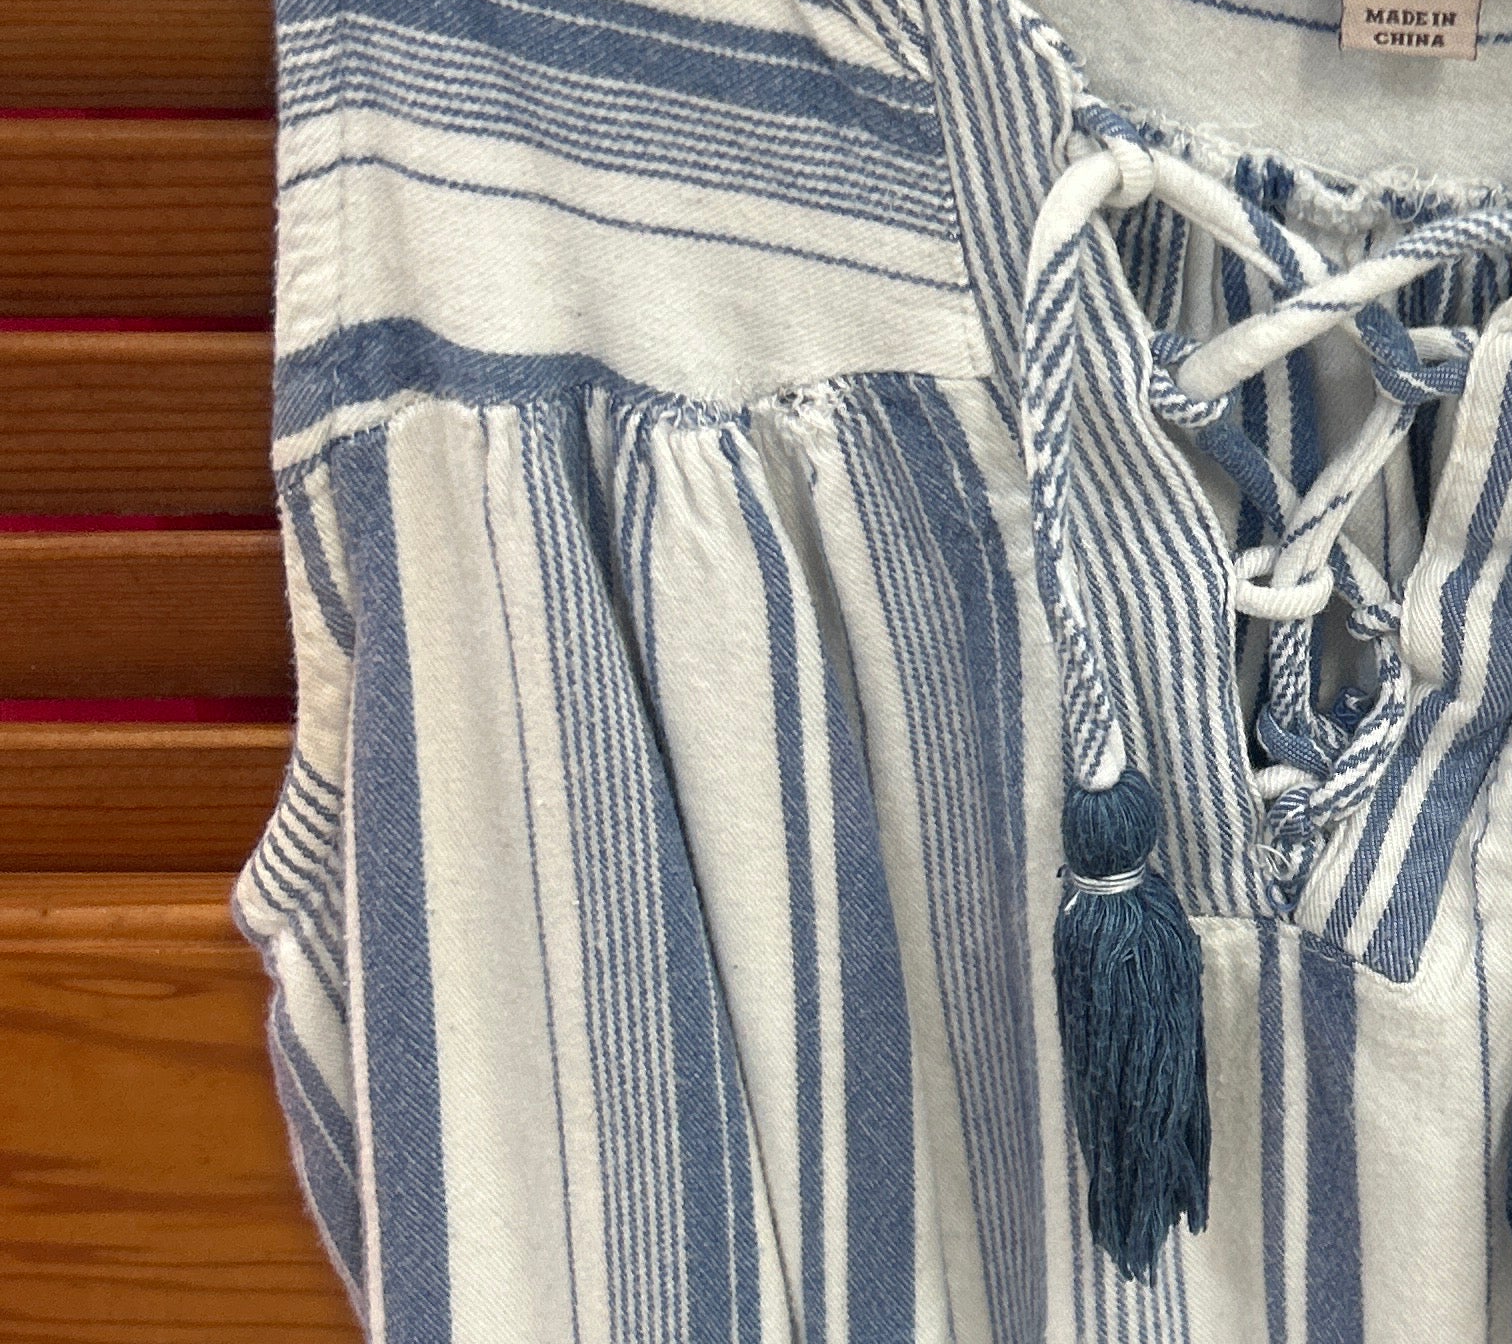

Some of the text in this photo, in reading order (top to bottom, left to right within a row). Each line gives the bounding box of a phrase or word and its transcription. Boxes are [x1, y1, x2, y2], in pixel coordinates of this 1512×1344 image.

[1365, 8, 1457, 27] MADE IN
[1373, 31, 1446, 48] CHINA
